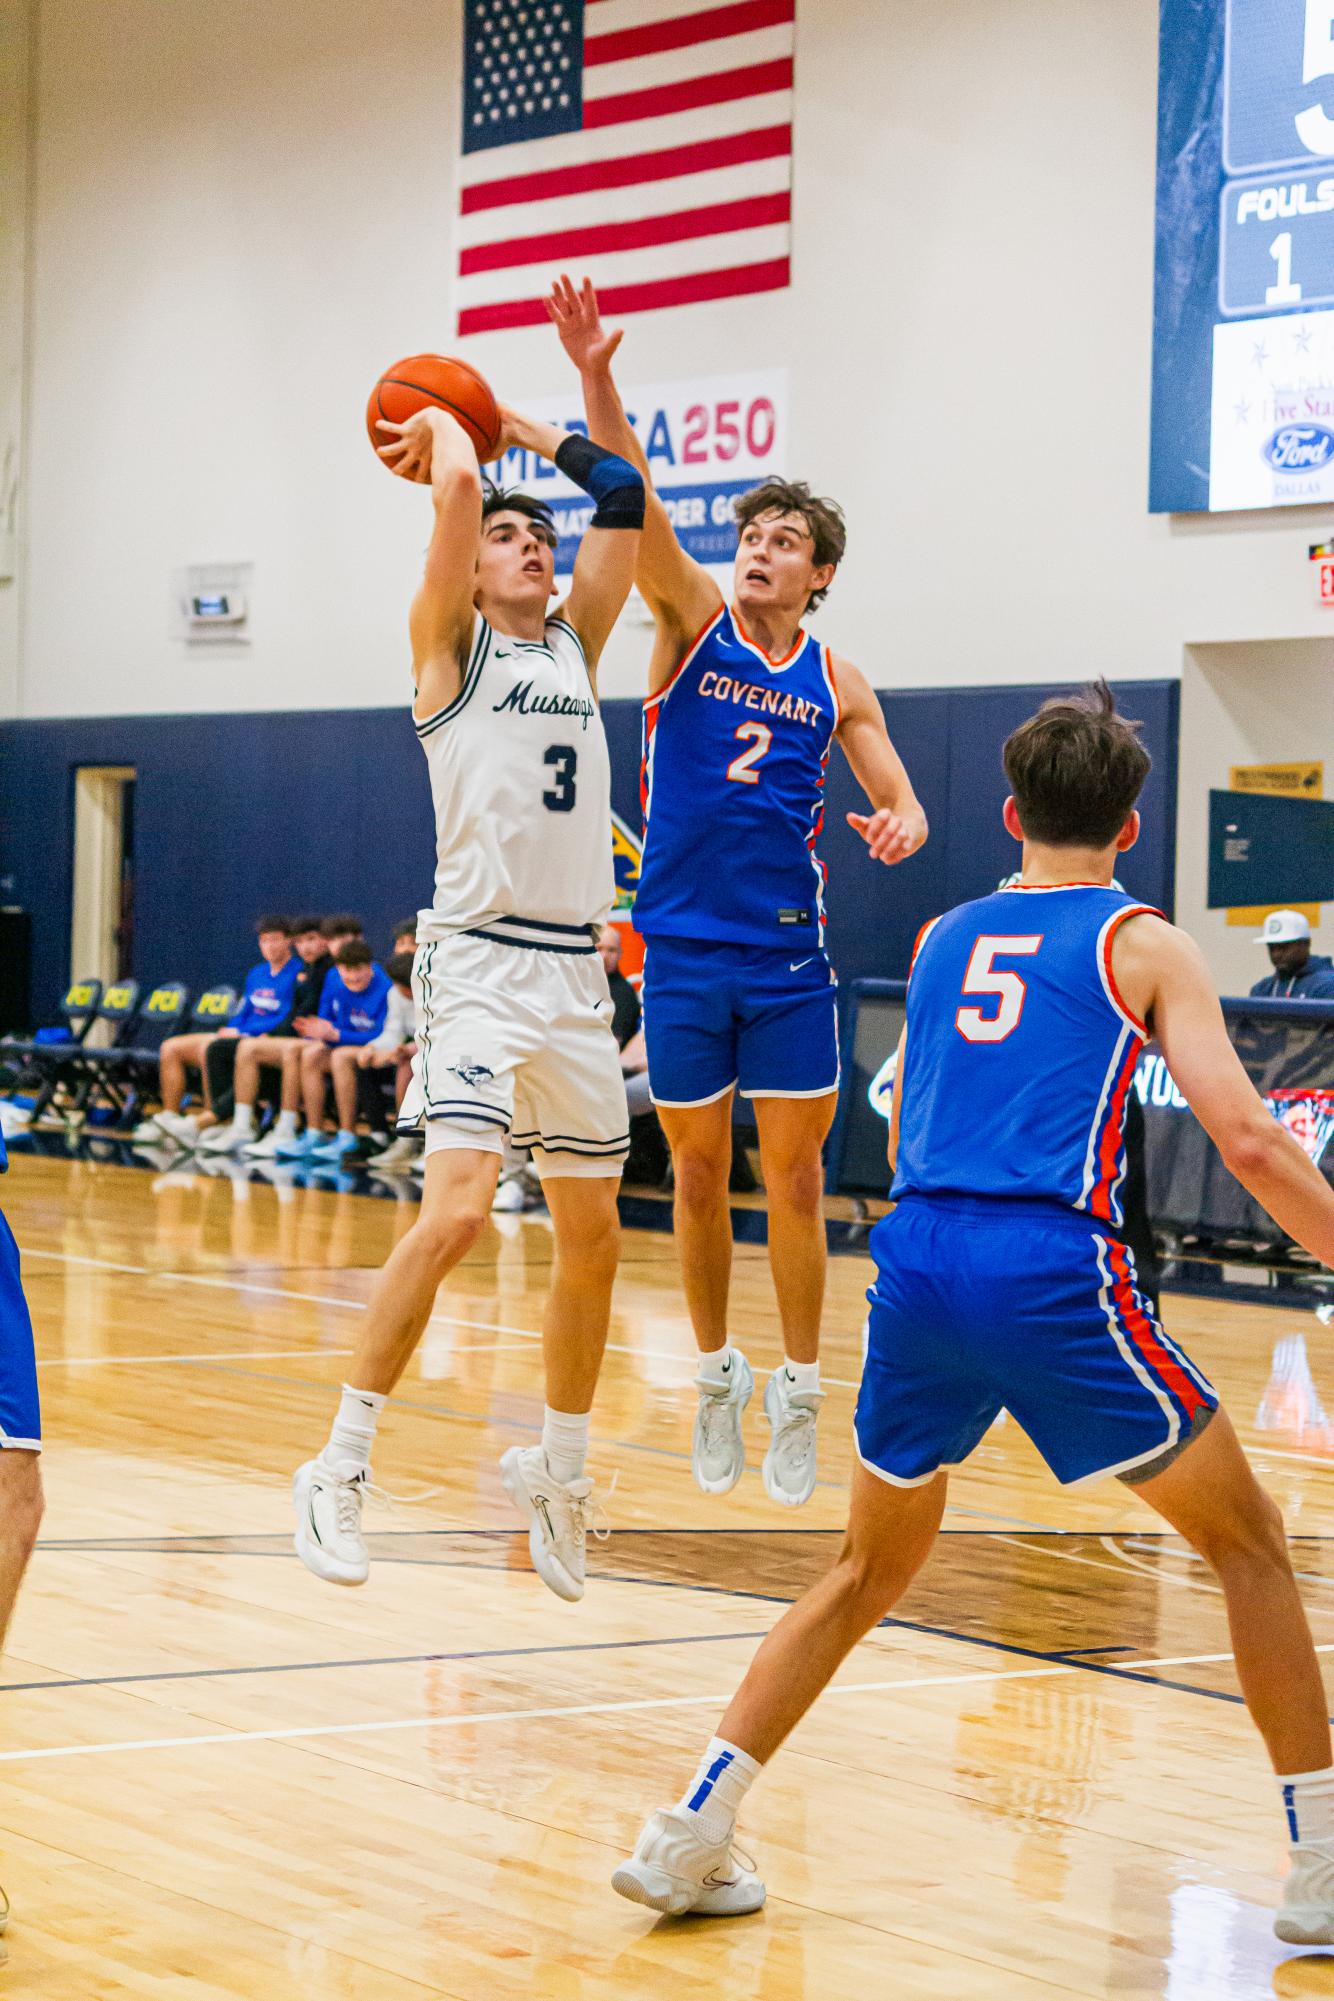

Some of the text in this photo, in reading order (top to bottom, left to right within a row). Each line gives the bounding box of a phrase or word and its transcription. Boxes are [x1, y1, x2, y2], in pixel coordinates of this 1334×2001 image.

[1237, 178, 1334, 224] FOULS
[1265, 232, 1301, 304] 1
[1272, 429, 1329, 466] Ford
[698, 671, 823, 727] COVENANT
[543, 745, 577, 812] 3
[726, 720, 773, 784] 2
[955, 934, 1044, 1043] 5
